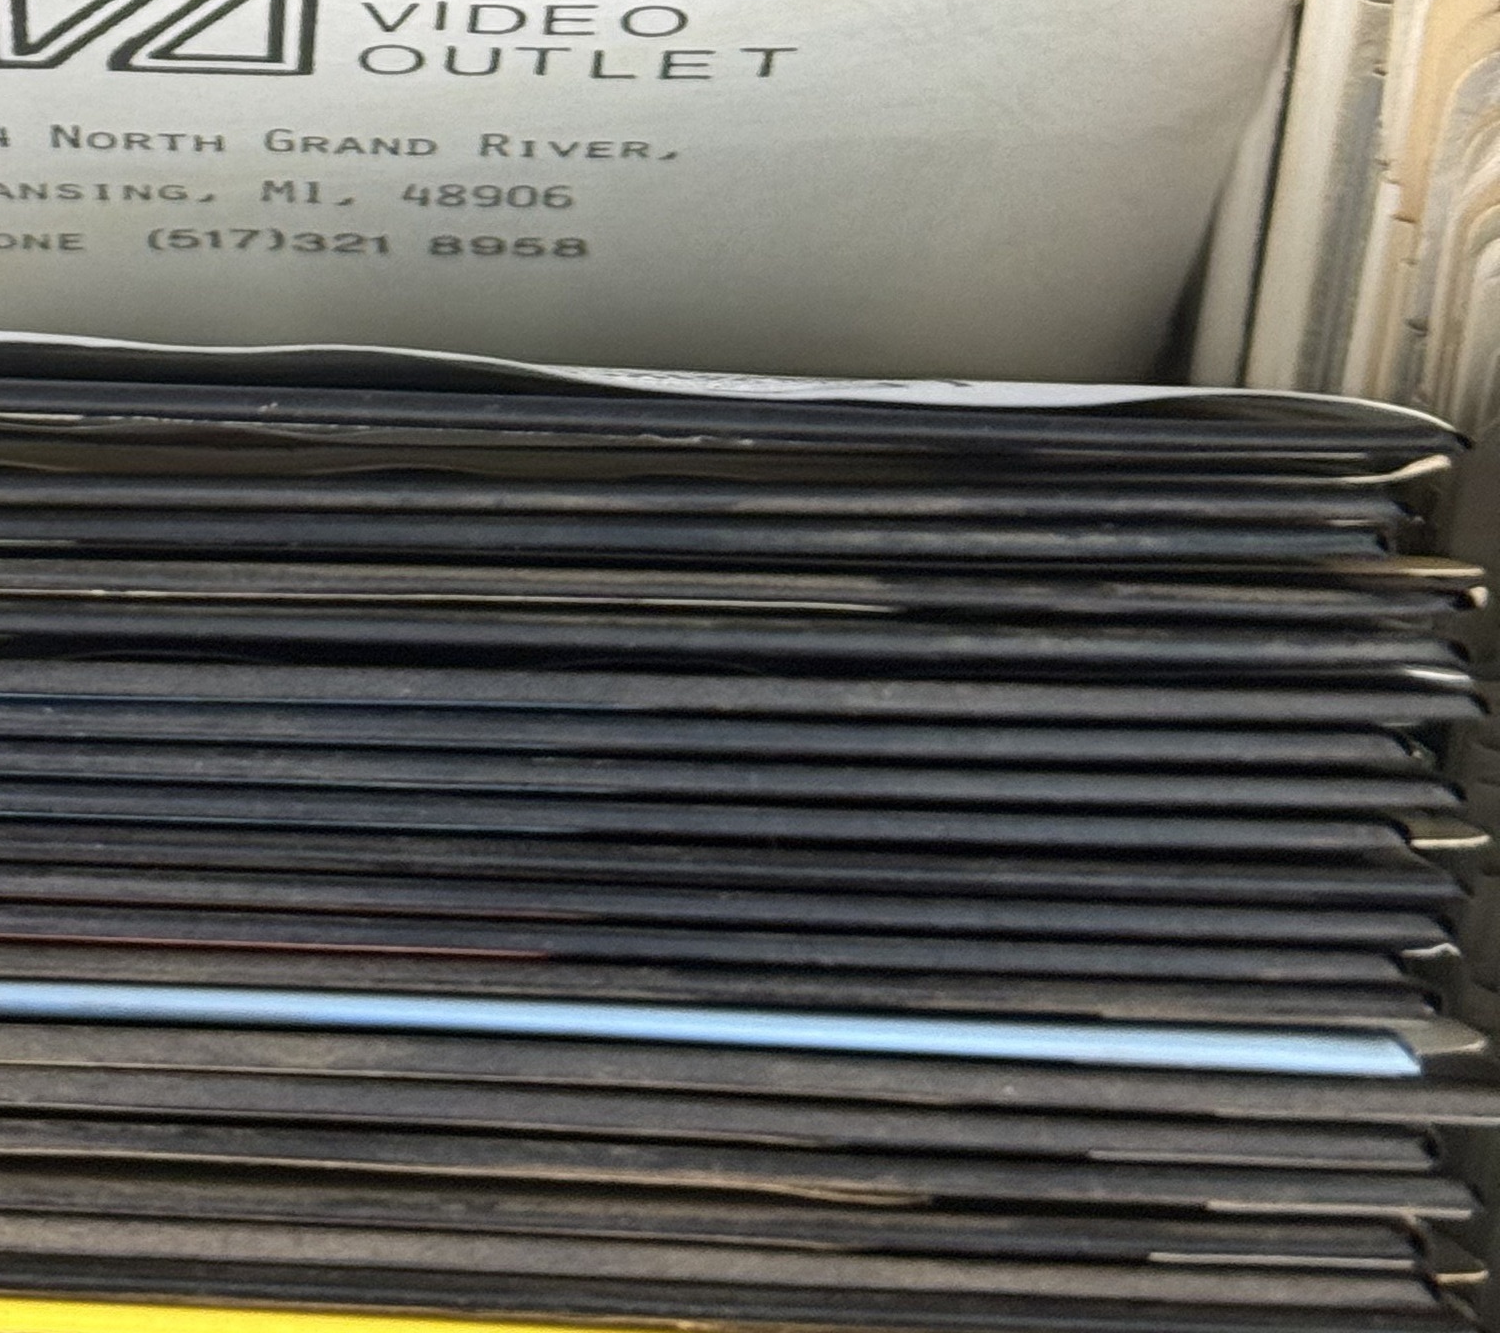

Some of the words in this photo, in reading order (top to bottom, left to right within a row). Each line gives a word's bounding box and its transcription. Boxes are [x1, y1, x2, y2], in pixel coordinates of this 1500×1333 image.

[361, 1, 689, 37] VIDEO
[357, 44, 799, 80] OUTLET
[49, 124, 226, 153] NORTH
[262, 128, 438, 156] GRAND
[401, 183, 574, 209] 48906
[147, 228, 391, 254] (517)321
[428, 235, 589, 258] 8958
